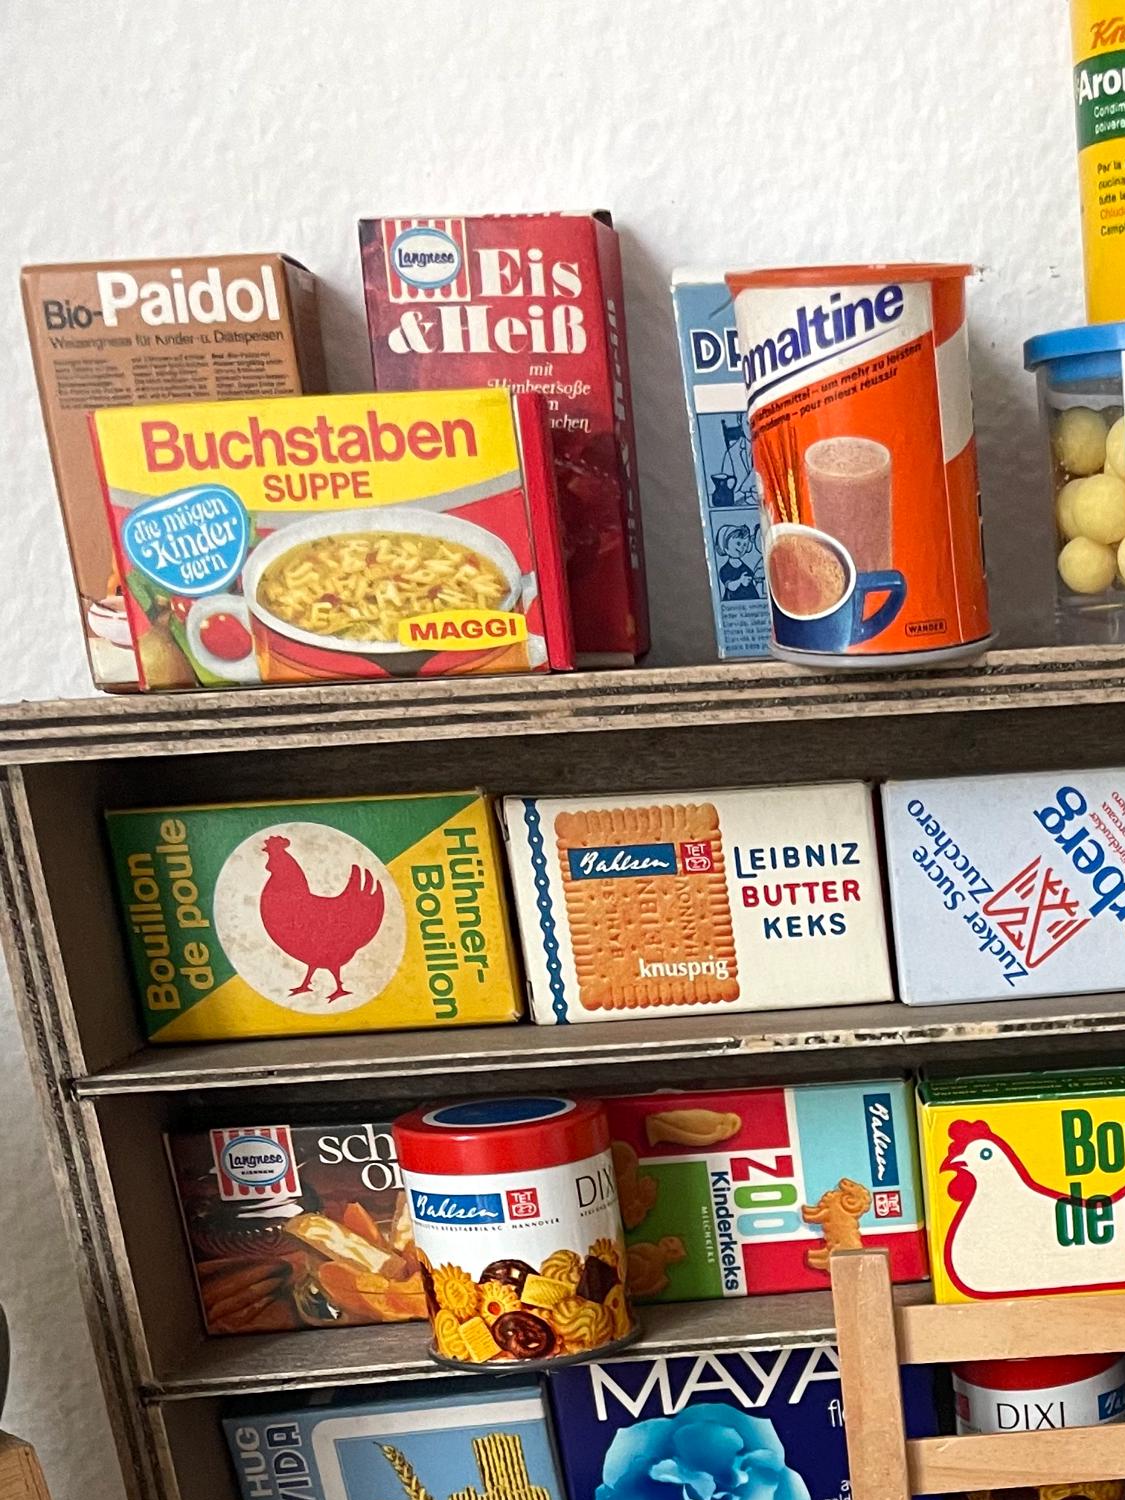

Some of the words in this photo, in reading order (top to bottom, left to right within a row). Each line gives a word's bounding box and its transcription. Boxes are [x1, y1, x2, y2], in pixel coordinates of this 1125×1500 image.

[398, 248, 454, 268] Langnese
[473, 248, 582, 298] Eis
[97, 265, 280, 327] Paidol
[529, 362, 553, 376] mit
[141, 411, 478, 473] Buchstaben
[263, 470, 373, 502] SUPPE
[134, 515, 160, 544] die
[164, 498, 229, 535] mögen
[142, 515, 236, 569] Kinder
[180, 556, 228, 582] gern
[410, 618, 517, 641] MAGGI
[156, 819, 209, 928] poule
[580, 851, 670, 875] Bahlsen
[734, 843, 860, 879] LEIBNIZ
[907, 799, 996, 904] Zucchero
[741, 879, 860, 908] BUTTER
[912, 845, 966, 911] Sucre
[127, 851, 180, 1011] Bouillon
[443, 826, 489, 984] Hühner-
[764, 913, 847, 939] KEKS
[180, 941, 214, 990] de
[411, 864, 458, 1019] Bouillon
[639, 955, 729, 980] knusprig
[963, 911, 1029, 987] Zucker
[229, 1153, 283, 1169] Langnese
[869, 1103, 891, 1180] Bahlsen
[417, 1194, 498, 1218] Bahlsen
[730, 1155, 801, 1236] ZOO
[1055, 1182, 1114, 1247] de
[710, 1171, 740, 1290] Kinderkeks
[590, 1346, 841, 1421] MAYA
[997, 1401, 1067, 1430] DIXI
[235, 1426, 273, 1497] HUG
